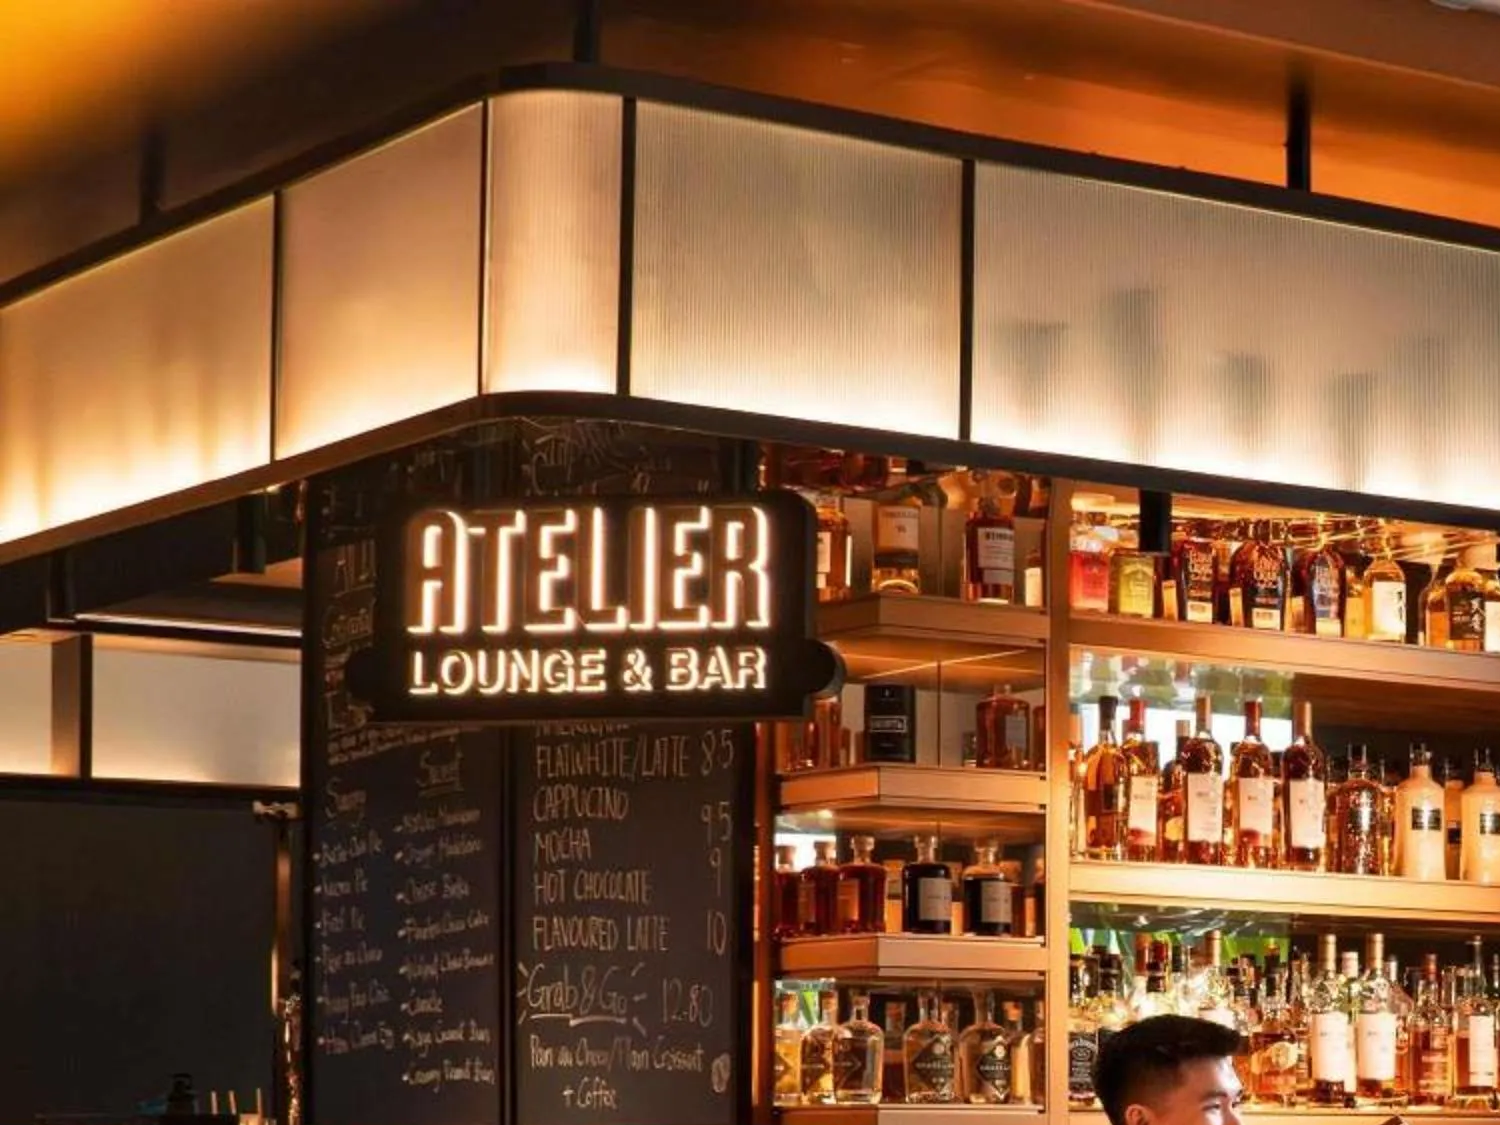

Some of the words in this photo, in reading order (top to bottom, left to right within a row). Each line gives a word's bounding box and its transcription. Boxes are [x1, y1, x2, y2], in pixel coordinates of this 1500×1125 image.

[407, 506, 771, 633] ATELIER
[409, 648, 607, 694] LOUNGE
[623, 648, 653, 691] &
[666, 646, 767, 691] BAR
[534, 869, 566, 906] HOT
[527, 962, 578, 1009] Grab
